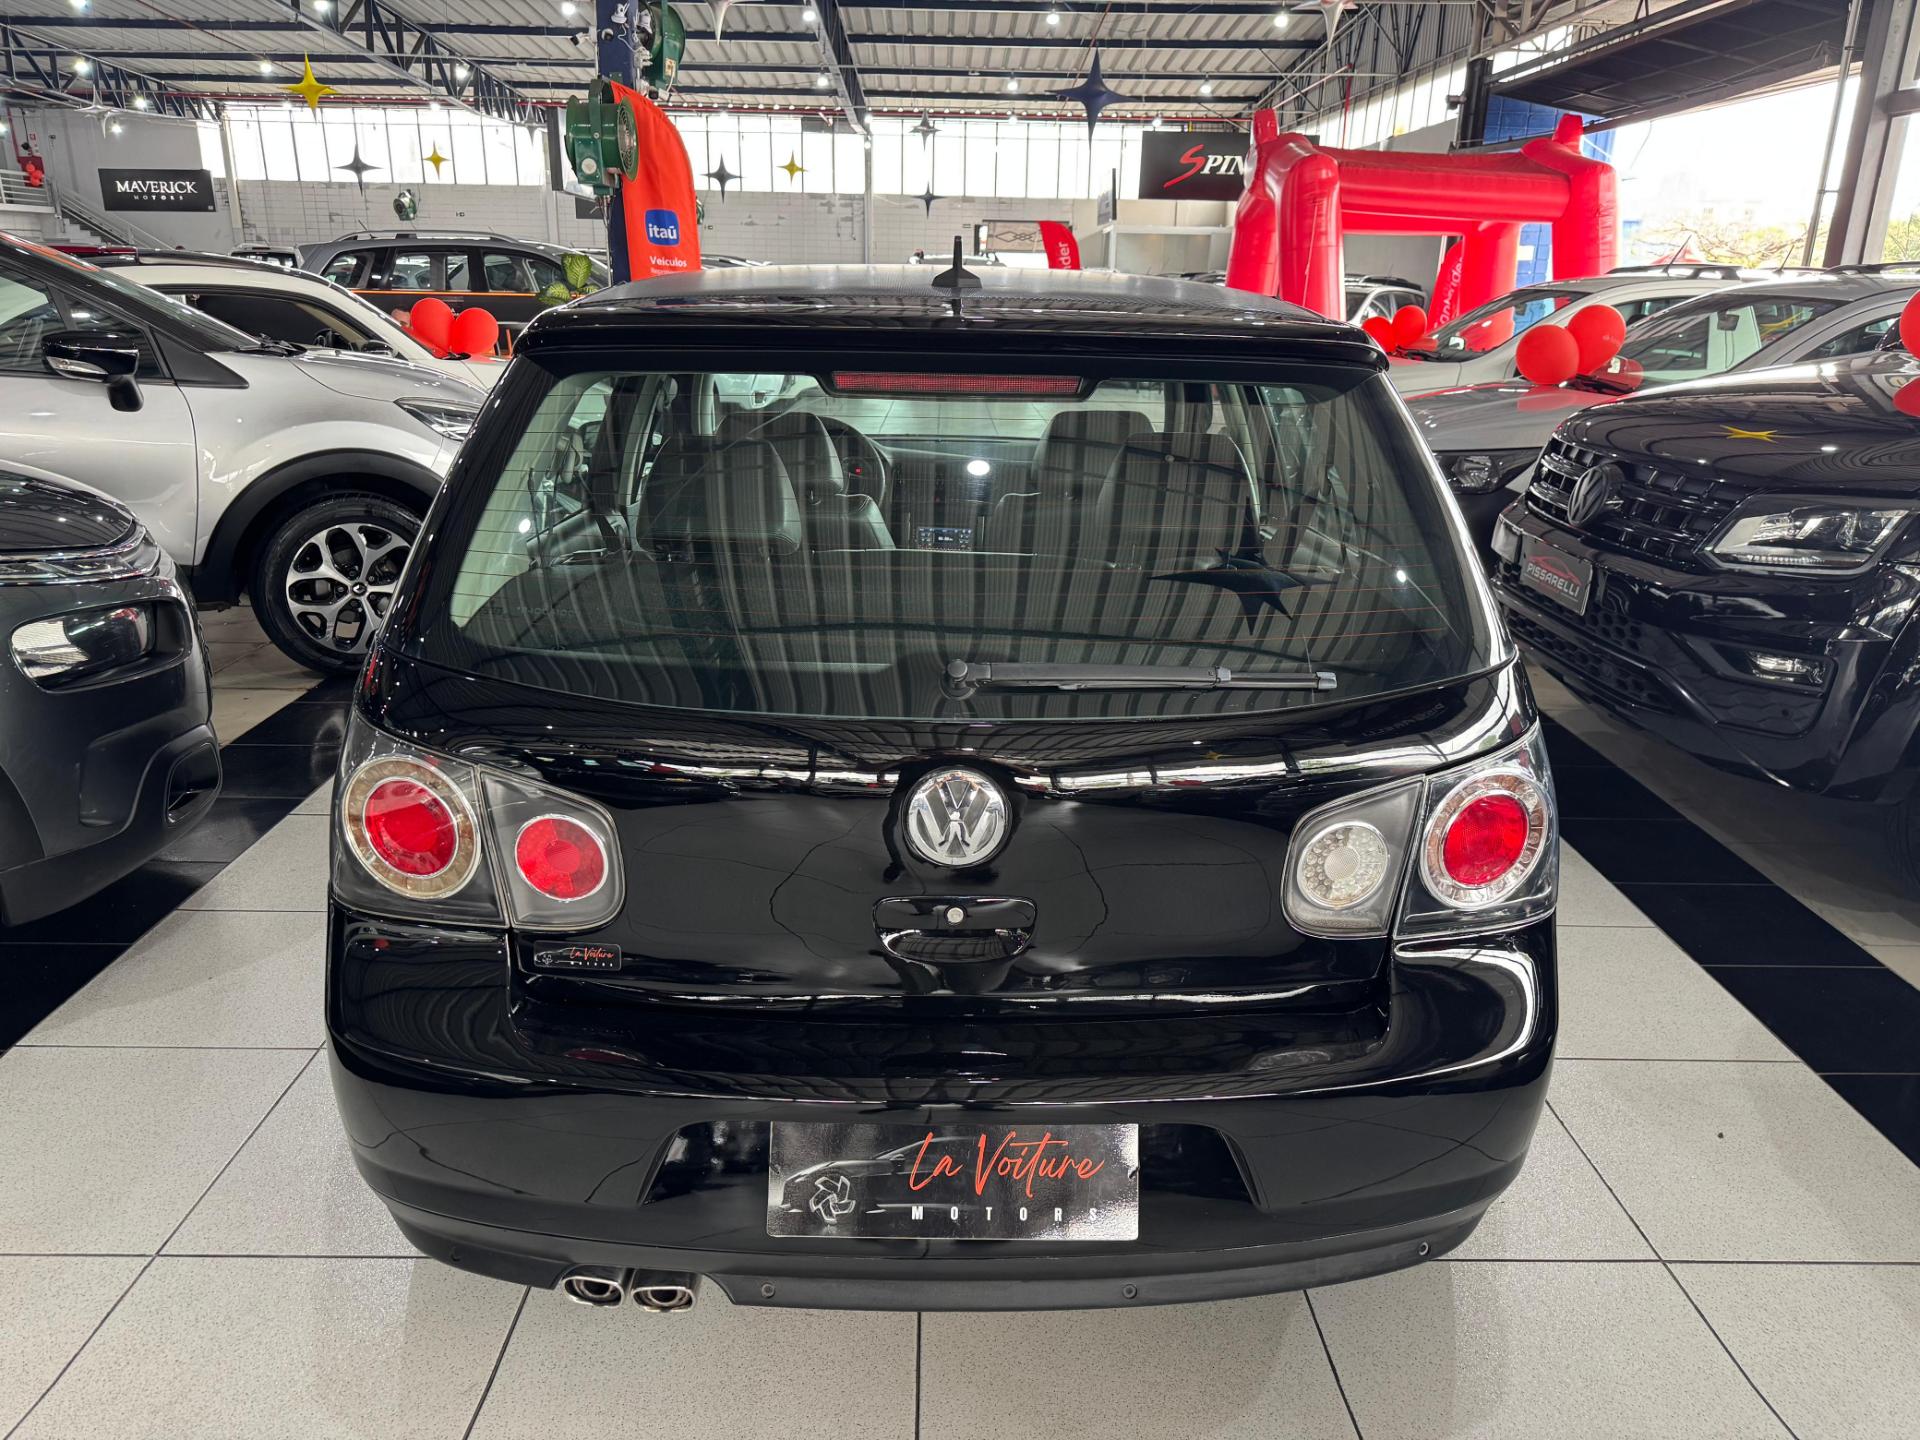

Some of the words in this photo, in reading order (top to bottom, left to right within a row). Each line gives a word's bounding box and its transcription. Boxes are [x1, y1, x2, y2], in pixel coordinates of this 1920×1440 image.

[115, 180, 198, 194] MAVERICK
[648, 223, 677, 240] itaú
[1526, 562, 1580, 598] PISSARELLI
[909, 1131, 964, 1191] La
[974, 1130, 1105, 1199] Voiture
[911, 1205, 1098, 1222] MOTORS
